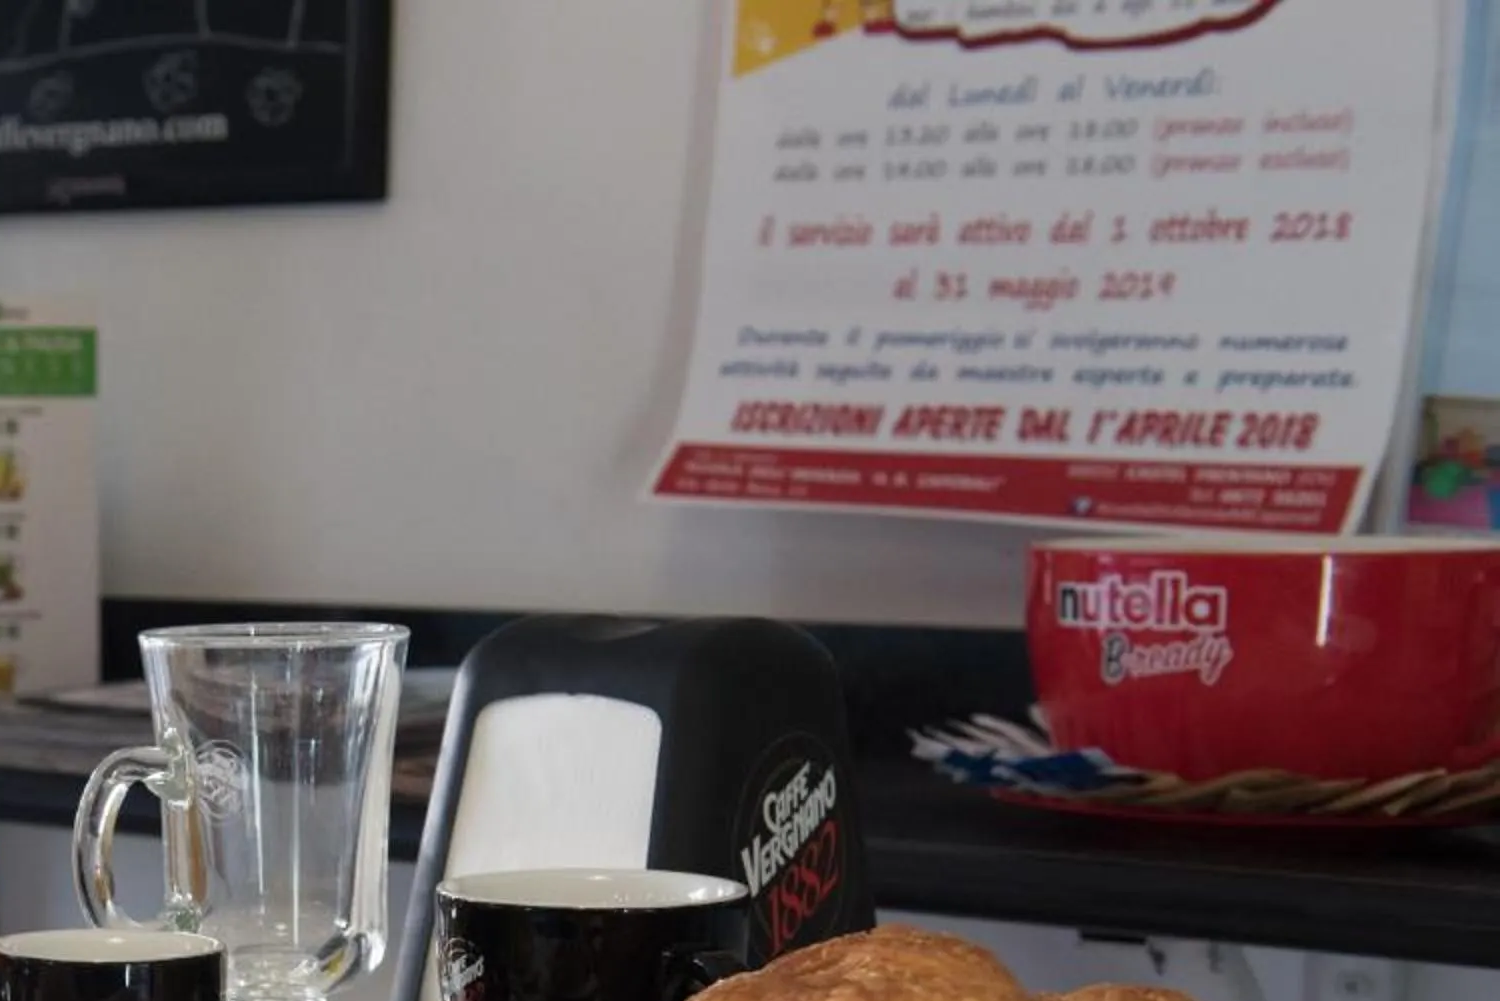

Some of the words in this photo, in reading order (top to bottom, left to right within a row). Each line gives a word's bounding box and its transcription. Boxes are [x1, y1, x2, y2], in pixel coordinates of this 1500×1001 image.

[1057, 73, 1086, 102] al
[889, 404, 1007, 442] APERTE
[1017, 406, 1072, 444] DAL
[1112, 409, 1232, 449] APRILE
[1234, 411, 1322, 451] 2018
[1057, 571, 1228, 631] nutella
[740, 766, 836, 898] VERGNANO
[768, 819, 840, 952] 1882
